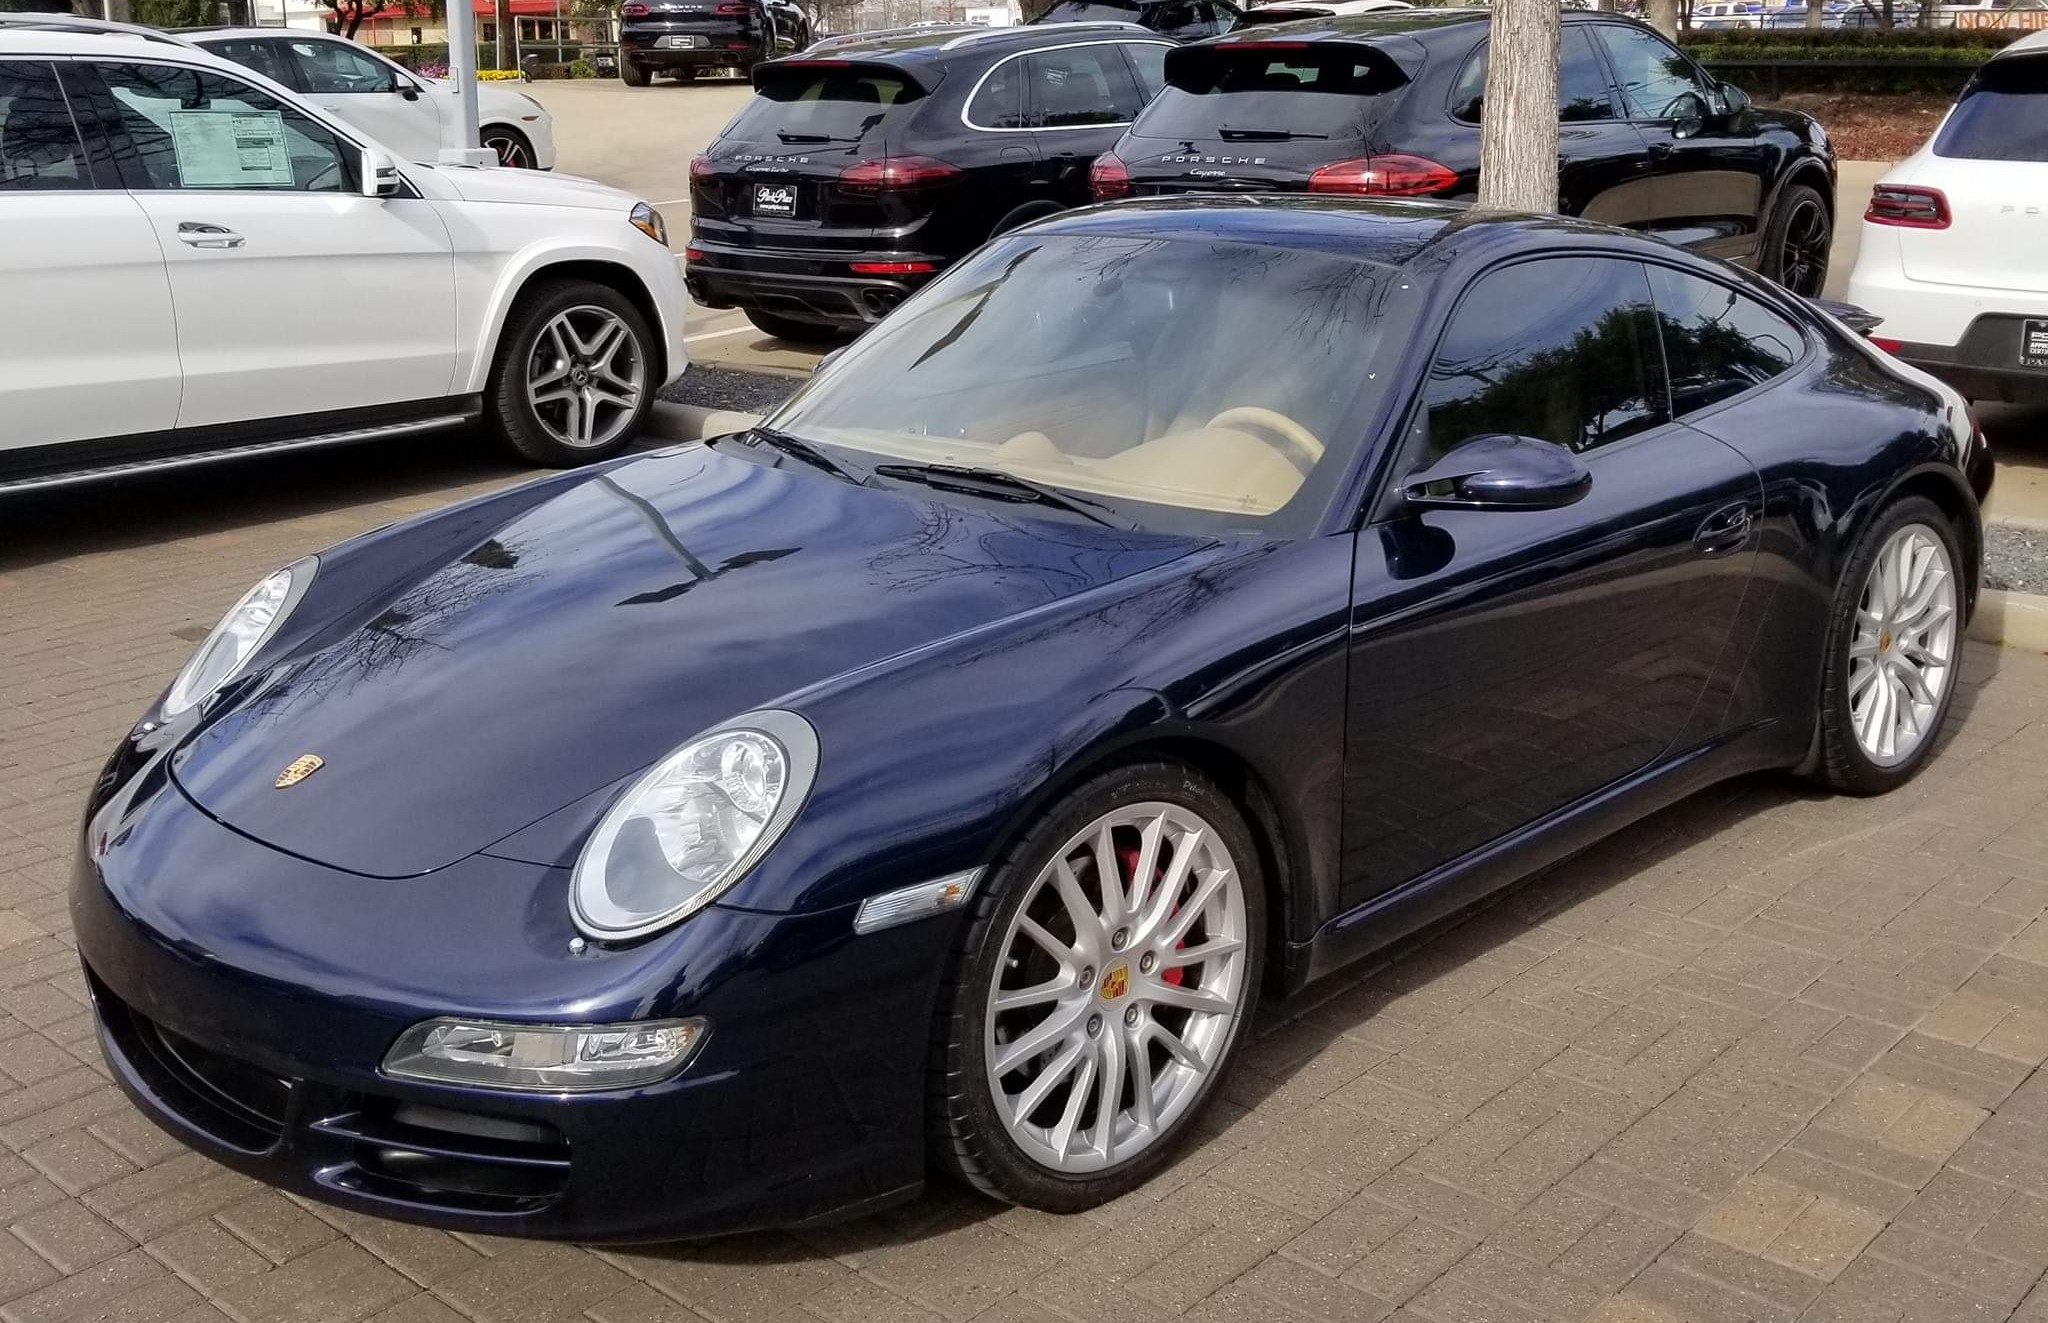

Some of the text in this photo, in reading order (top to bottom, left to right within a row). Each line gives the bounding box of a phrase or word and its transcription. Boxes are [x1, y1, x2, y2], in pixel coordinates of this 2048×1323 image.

[1959, 11, 2011, 30] NOW
[735, 155, 809, 163] PORSCHE
[1161, 156, 1266, 165] PORSCHE
